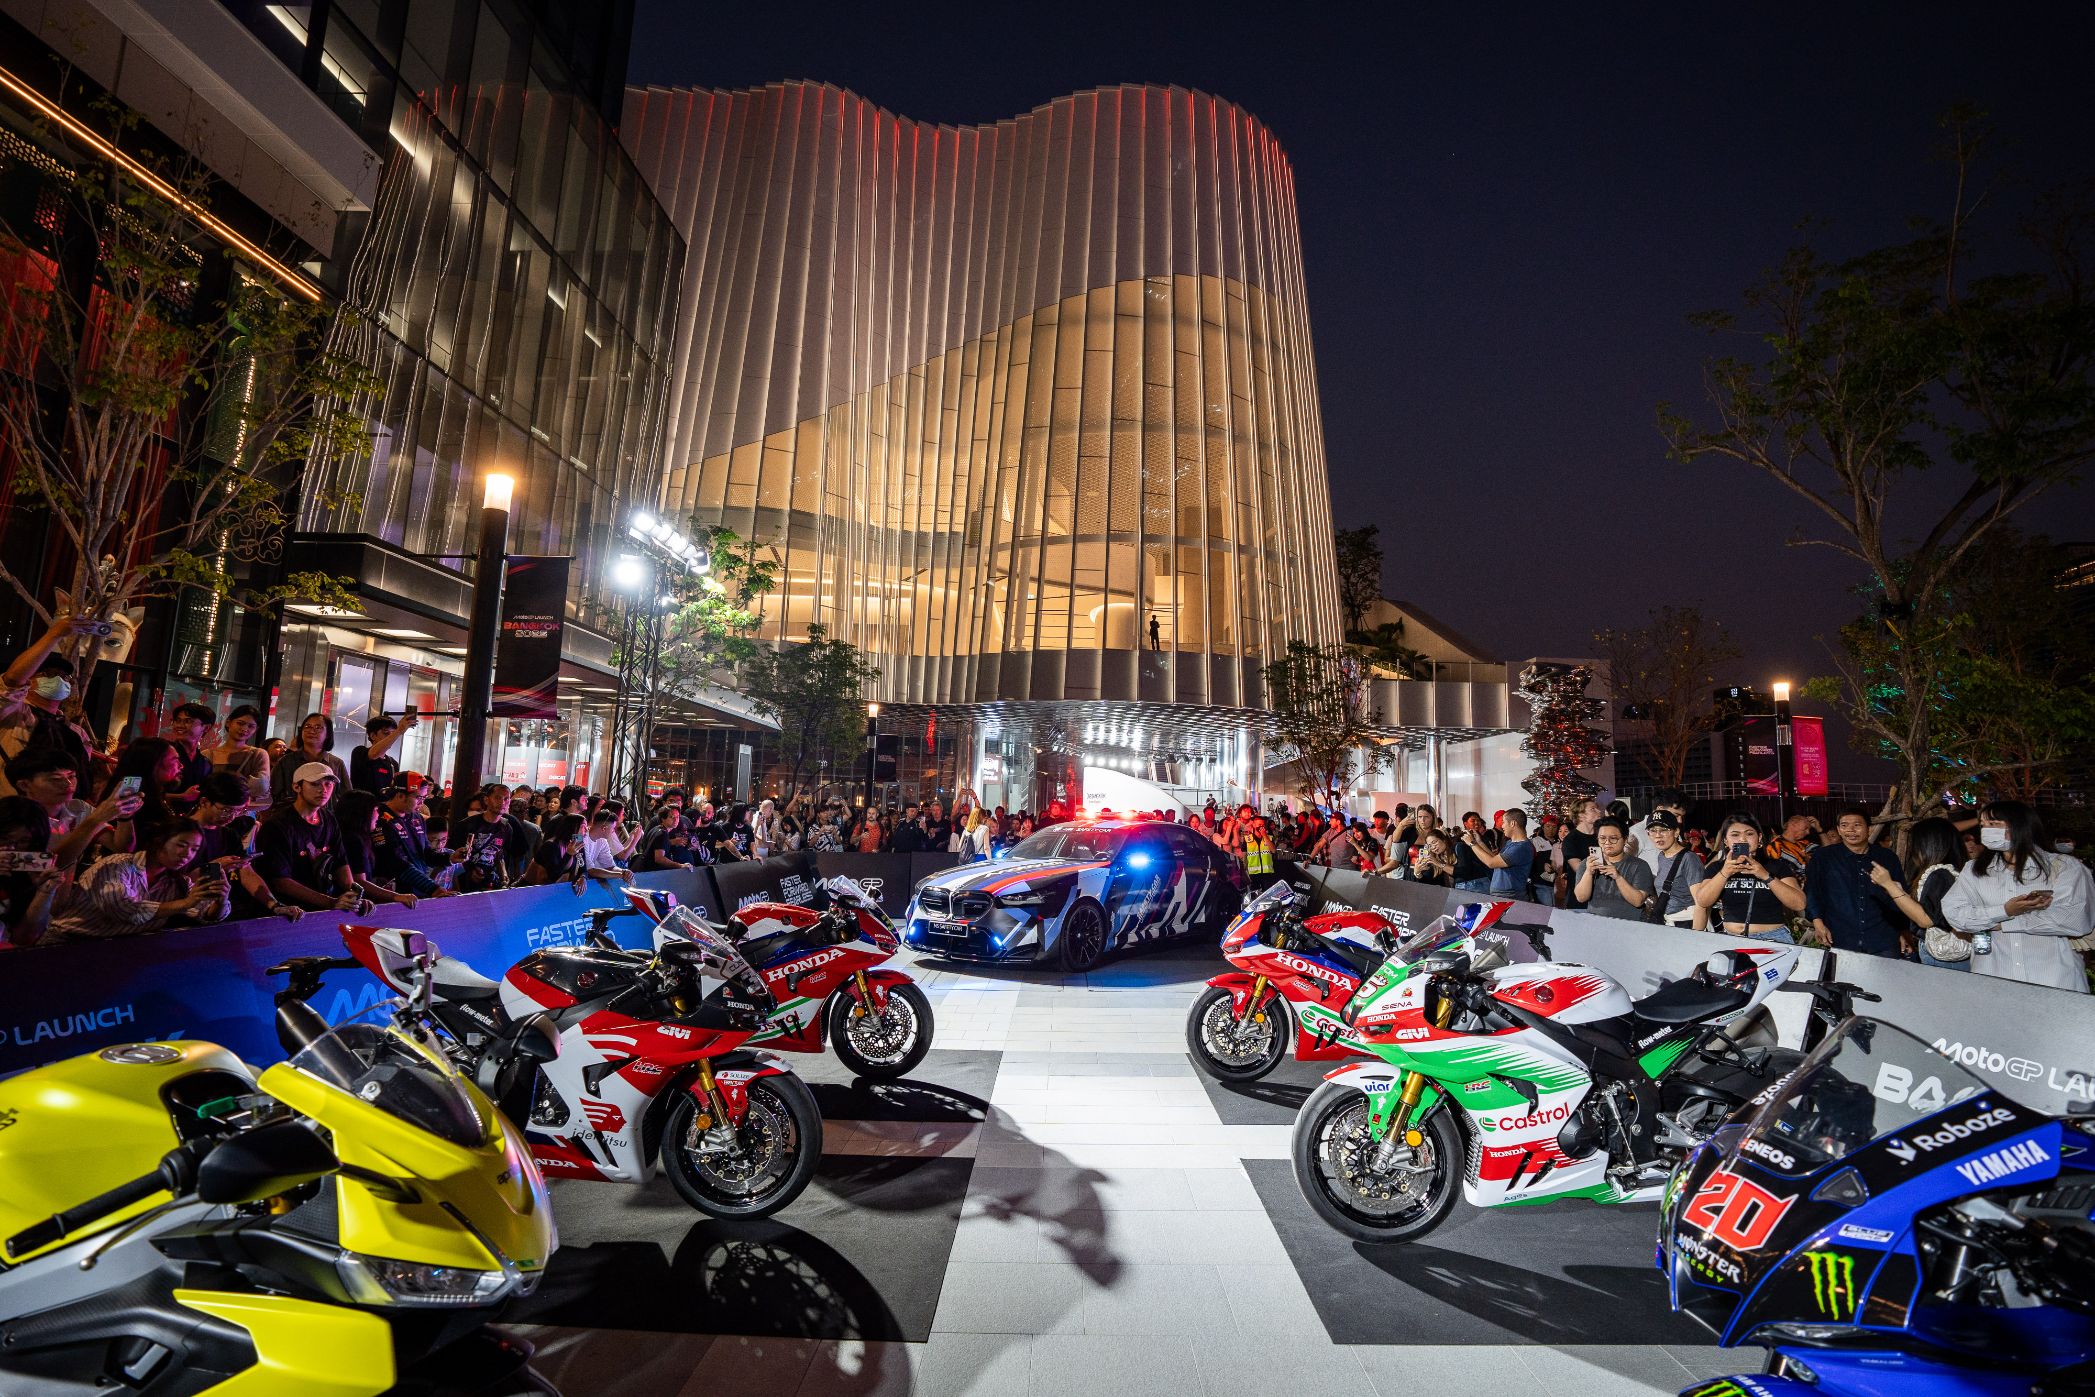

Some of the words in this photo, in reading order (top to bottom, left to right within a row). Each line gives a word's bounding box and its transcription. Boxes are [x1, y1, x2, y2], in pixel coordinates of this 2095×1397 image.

[503, 621, 560, 631] BANGKOK
[766, 948, 847, 983] HONDA
[1275, 951, 1353, 992] HONDA
[459, 1003, 495, 1027] flow-meter
[727, 1001, 756, 1011] HONDA
[1367, 1013, 1397, 1023] HONDA
[1381, 1001, 1413, 1011] SENA
[14, 1004, 135, 1046] LAUNCH
[1395, 1027, 1431, 1040] GIVI
[1638, 1025, 1673, 1050] flow-meter
[1924, 1037, 2044, 1082] MotoGP
[1364, 1081, 1391, 1093] viar
[1464, 1079, 1493, 1094] HRC
[1499, 1101, 1570, 1132] Castrol
[1912, 1107, 2017, 1153] Roboze
[534, 1157, 580, 1169] NDA
[1490, 1146, 1528, 1159] HONDA
[1744, 1138, 1797, 1171] ENEOS
[1955, 1139, 2051, 1187] YAMAHA
[1682, 1161, 1799, 1251] 20
[1677, 1232, 1741, 1284] MONSTER
